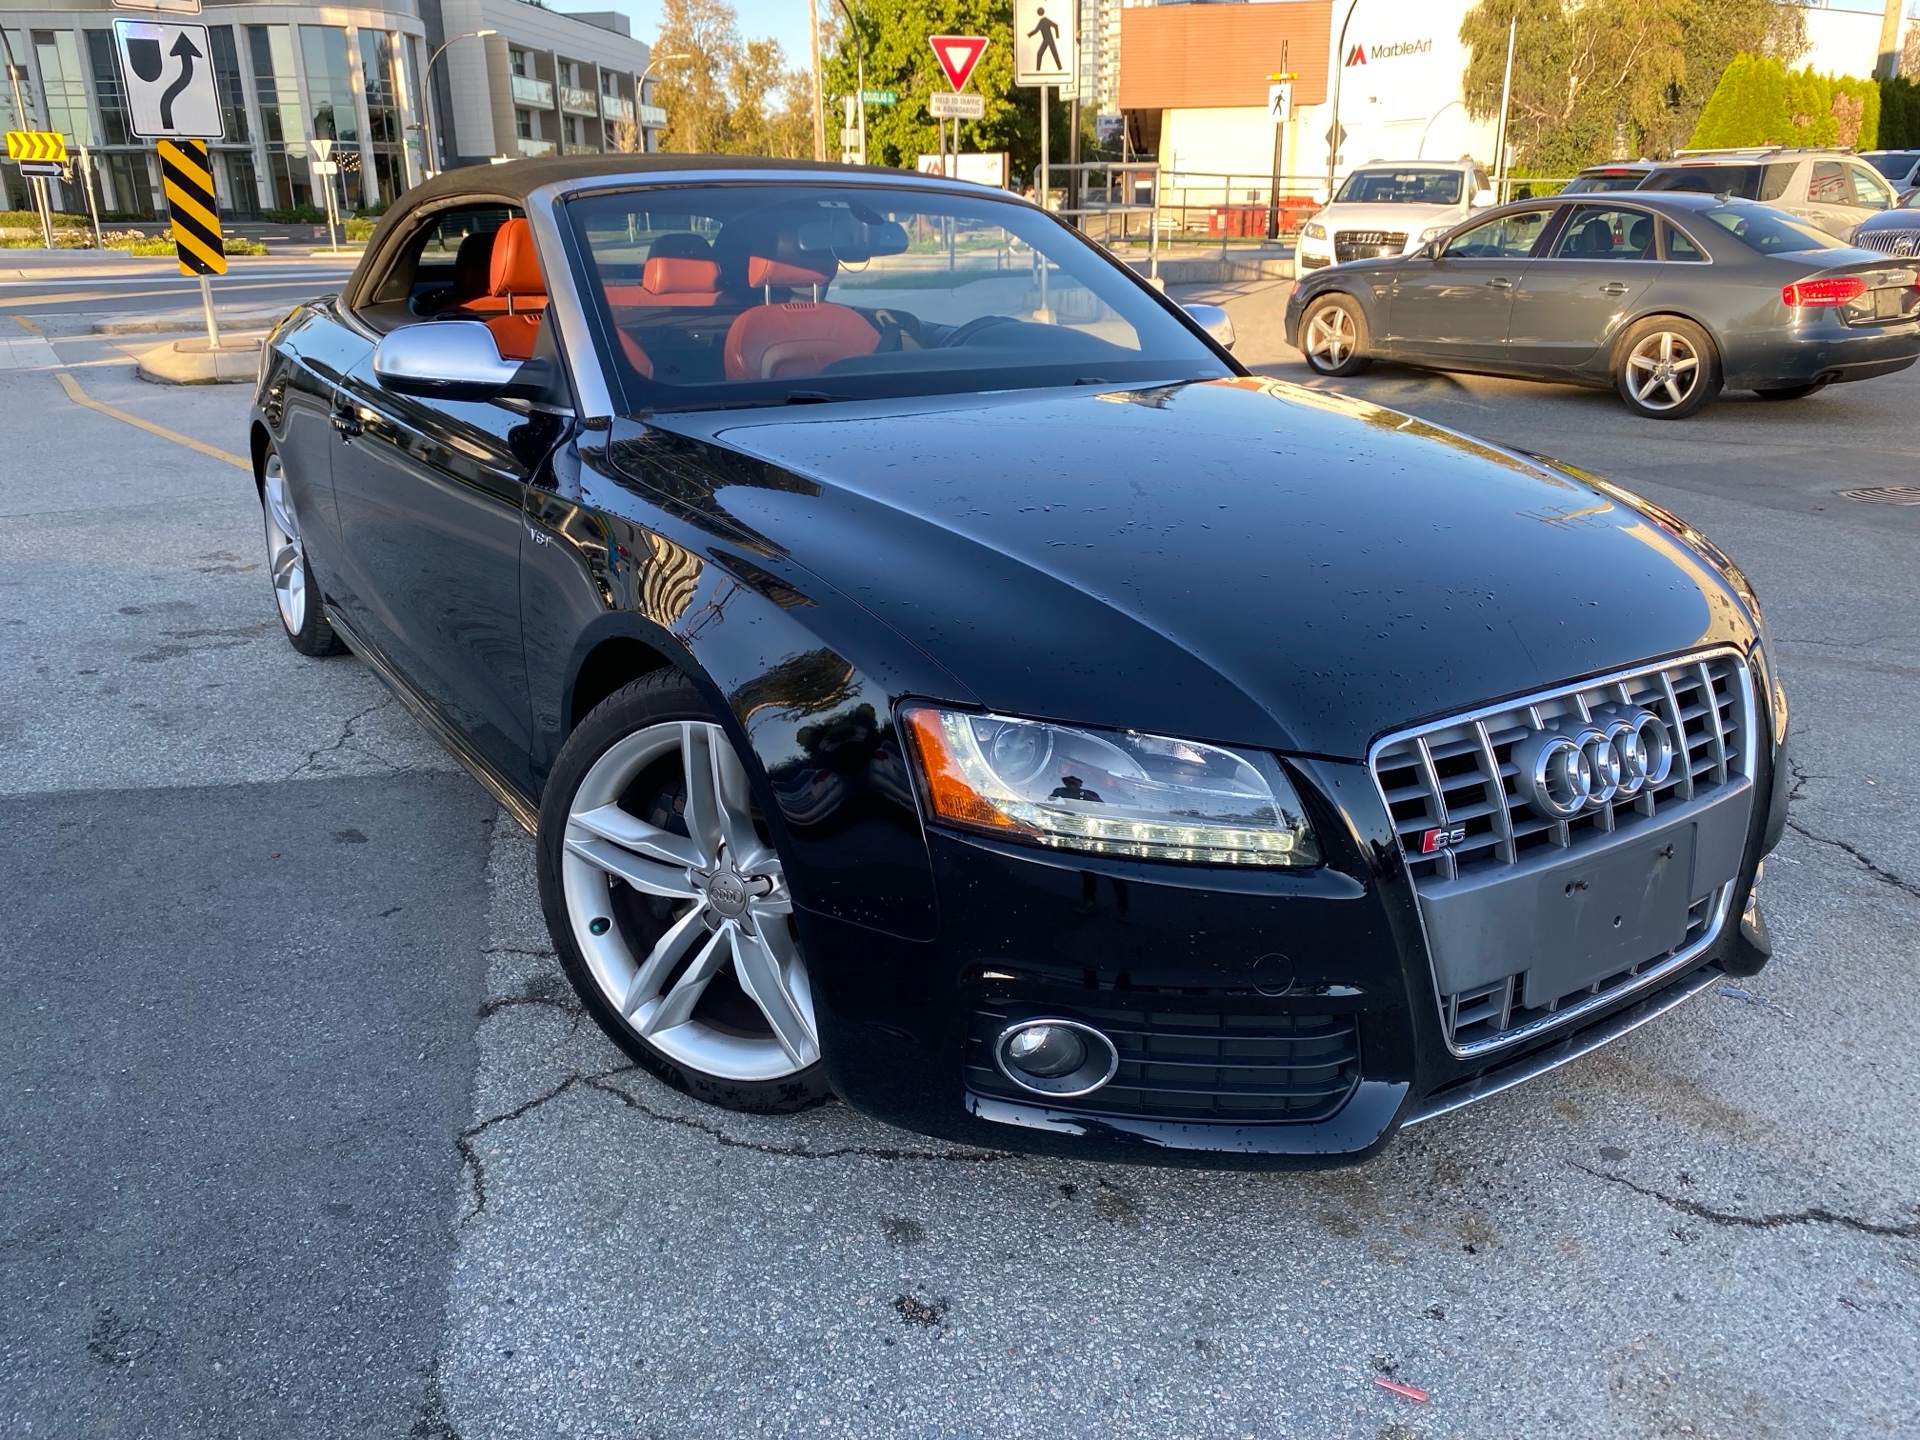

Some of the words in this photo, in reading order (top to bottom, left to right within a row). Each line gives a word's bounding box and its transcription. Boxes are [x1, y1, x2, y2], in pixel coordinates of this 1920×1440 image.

[1370, 37, 1433, 60] MarbleArt
[863, 91, 887, 103] DOUGLAS
[934, 96, 950, 104] YIELD
[951, 97, 959, 105] TO
[960, 97, 981, 106] TRAFFIC
[943, 105, 980, 115] ROUNDABOUT
[1432, 828, 1466, 849] S5
